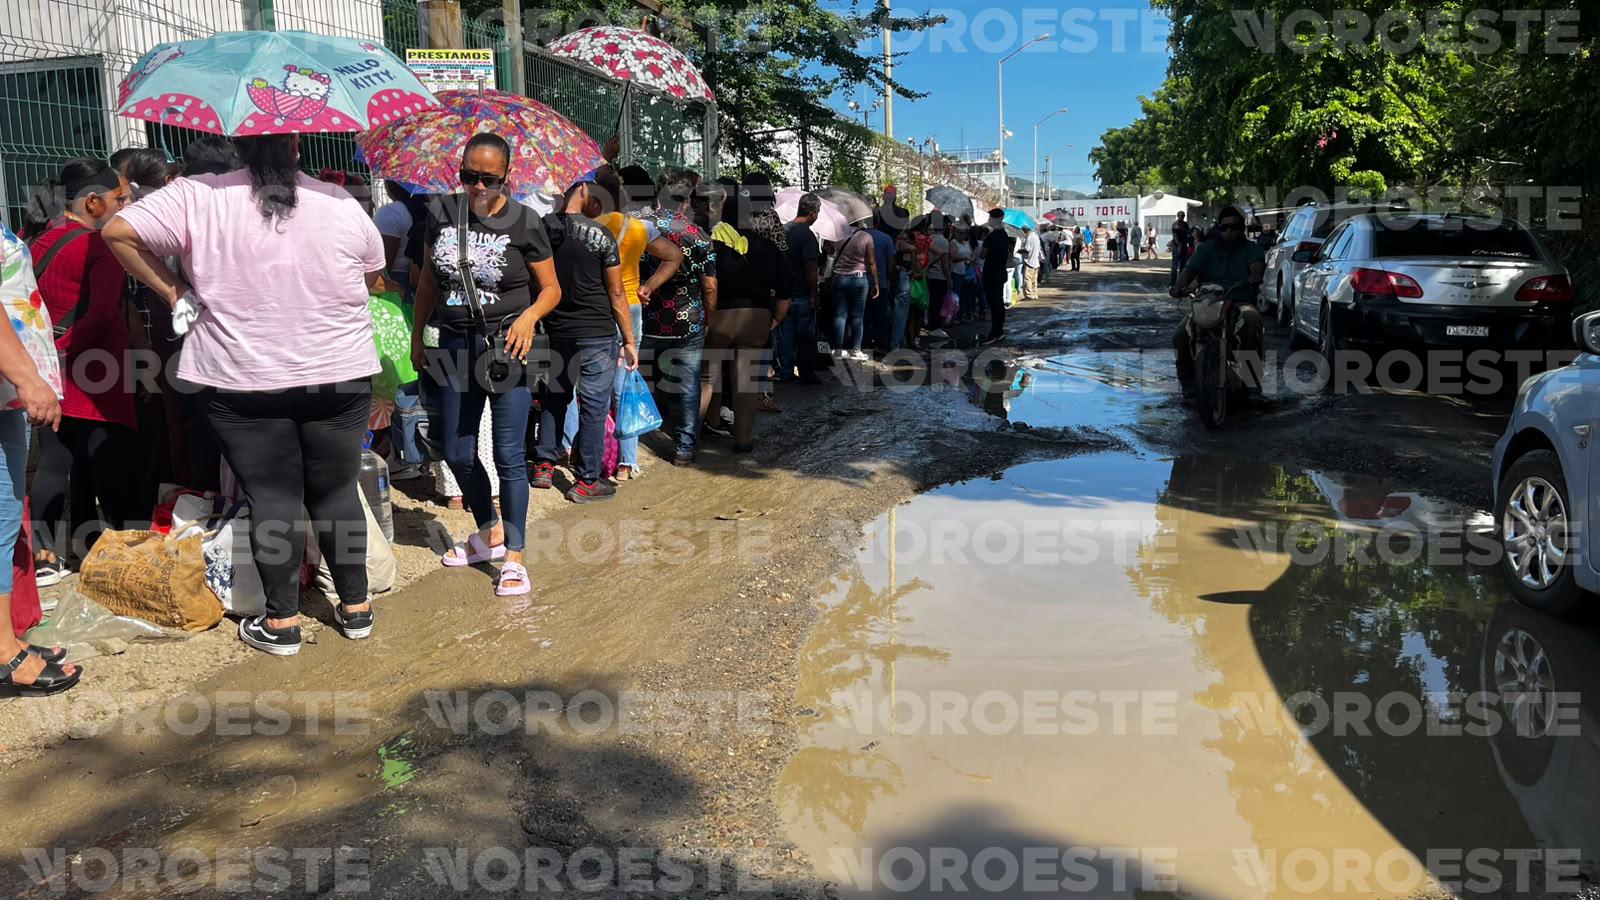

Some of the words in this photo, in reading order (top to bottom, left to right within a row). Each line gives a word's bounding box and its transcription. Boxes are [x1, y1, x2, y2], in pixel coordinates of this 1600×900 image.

[408, 51, 490, 60] PRESTAMOS
[333, 58, 380, 75] HELLO
[349, 69, 394, 90] KITTY
[1095, 205, 1131, 216] TOTAL
